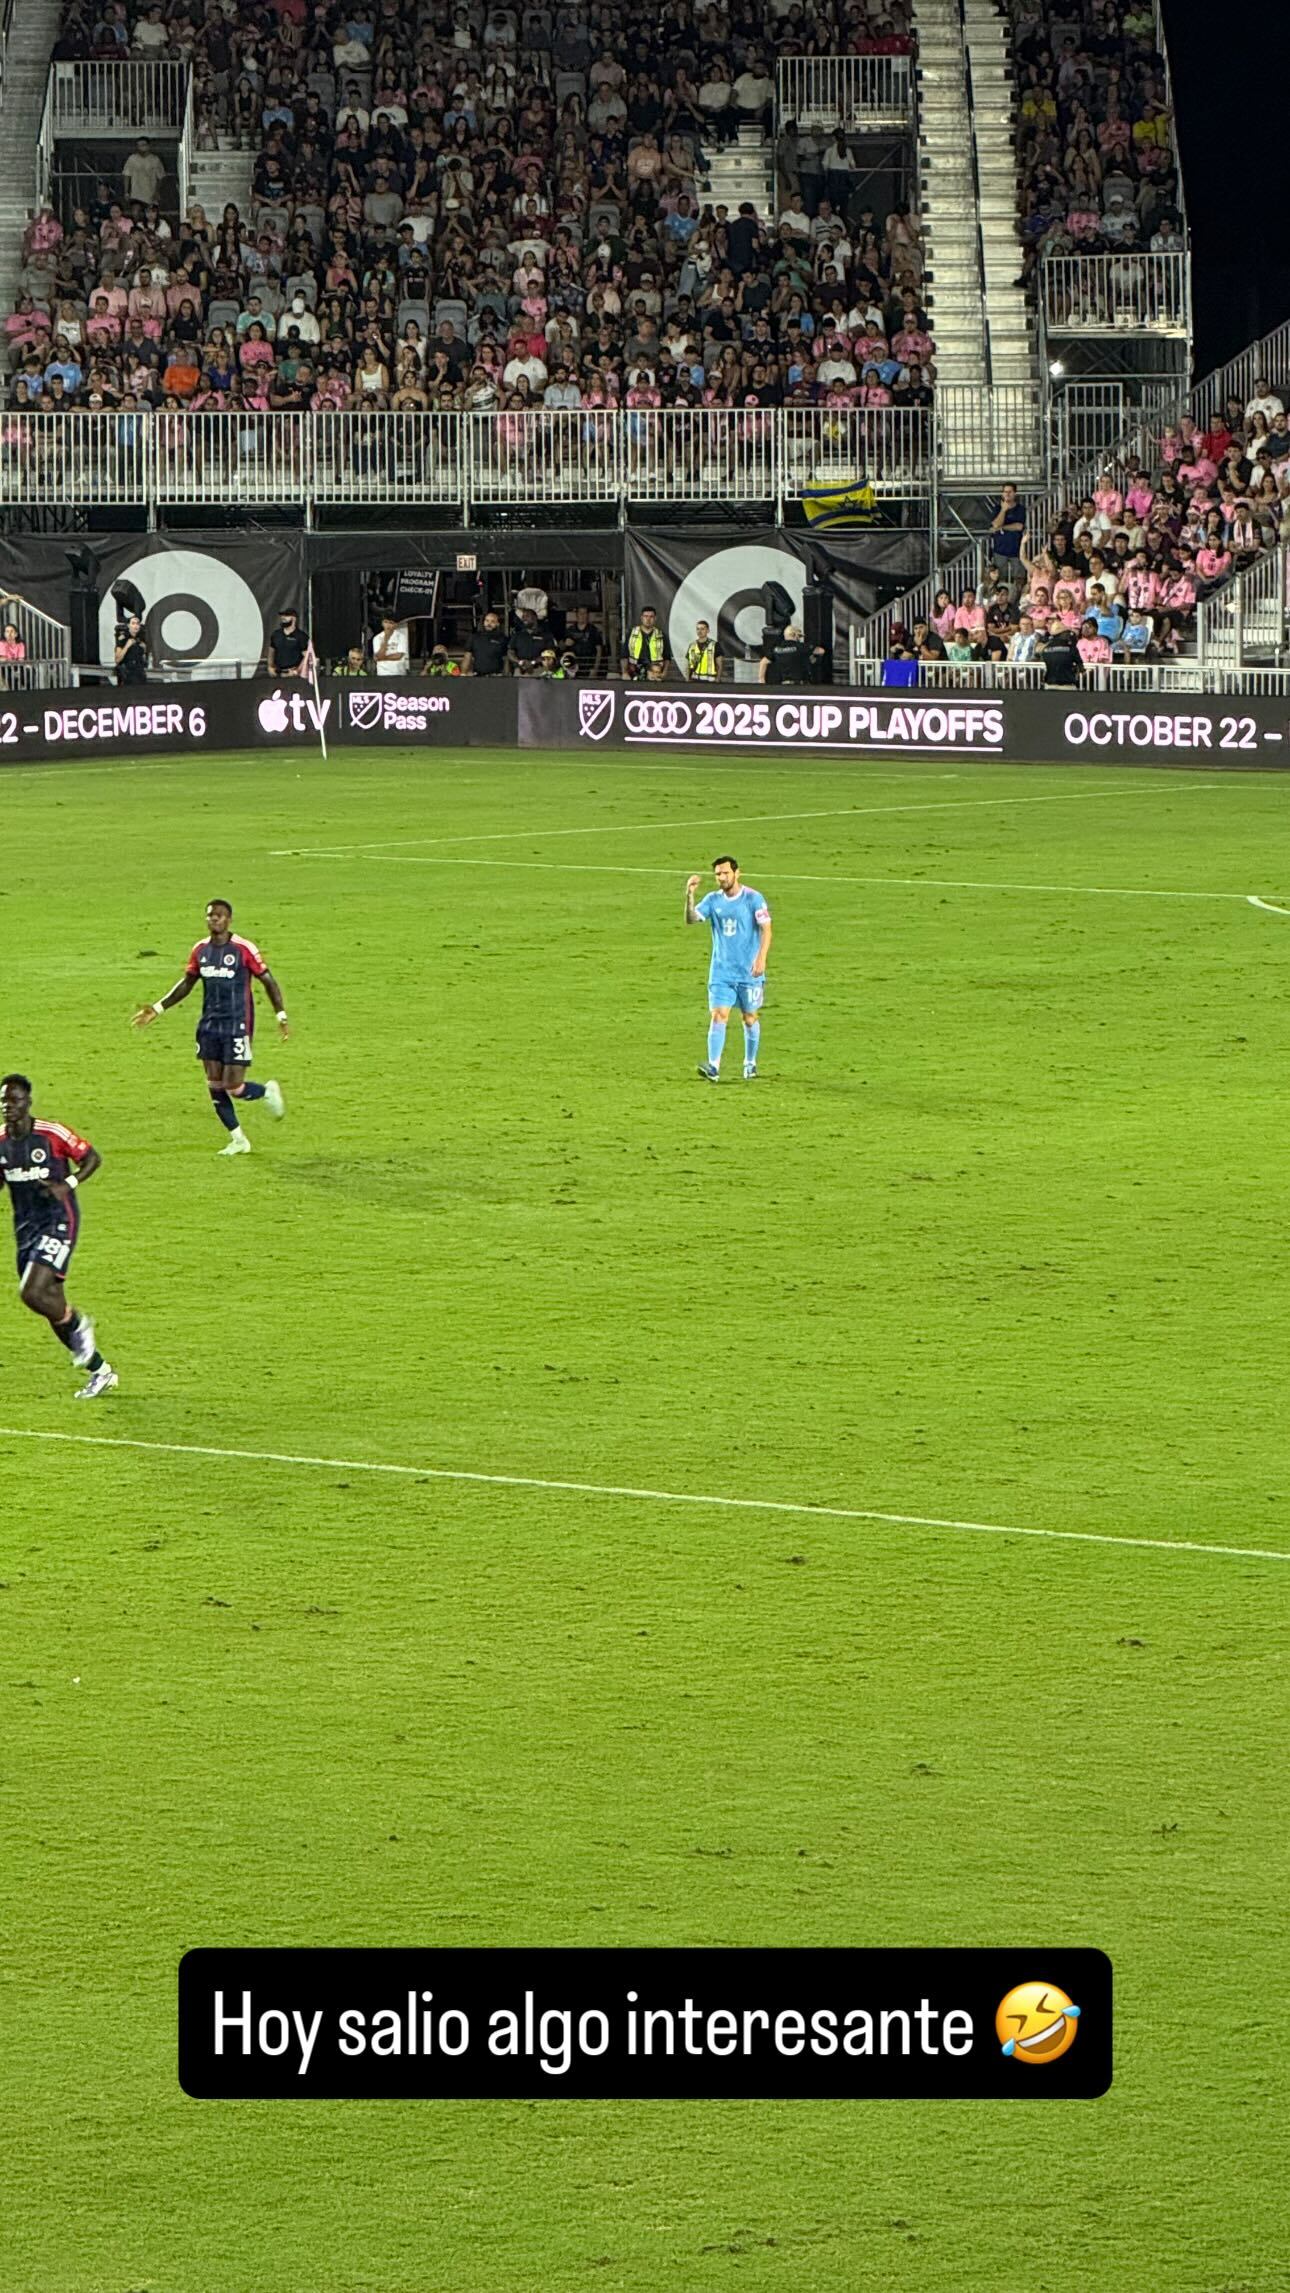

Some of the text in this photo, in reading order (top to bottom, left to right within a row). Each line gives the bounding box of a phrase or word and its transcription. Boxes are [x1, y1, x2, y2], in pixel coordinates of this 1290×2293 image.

[458, 558, 475, 569] EXIT
[400, 578, 434, 586] PROGRAM
[403, 570, 433, 578] LOYALTY
[383, 692, 450, 712] Season
[582, 694, 602, 706] MLS
[289, 693, 331, 731] tv
[383, 711, 427, 730] Pass
[0, 712, 19, 743] 2
[44, 704, 183, 741] DECEMBER
[189, 707, 206, 737] 6
[695, 702, 1004, 743] 2025 CUP PLAYOFFS
[1064, 713, 1212, 748] OCTOBER
[1219, 717, 1258, 749] 22
[746, 987, 761, 1002] 10
